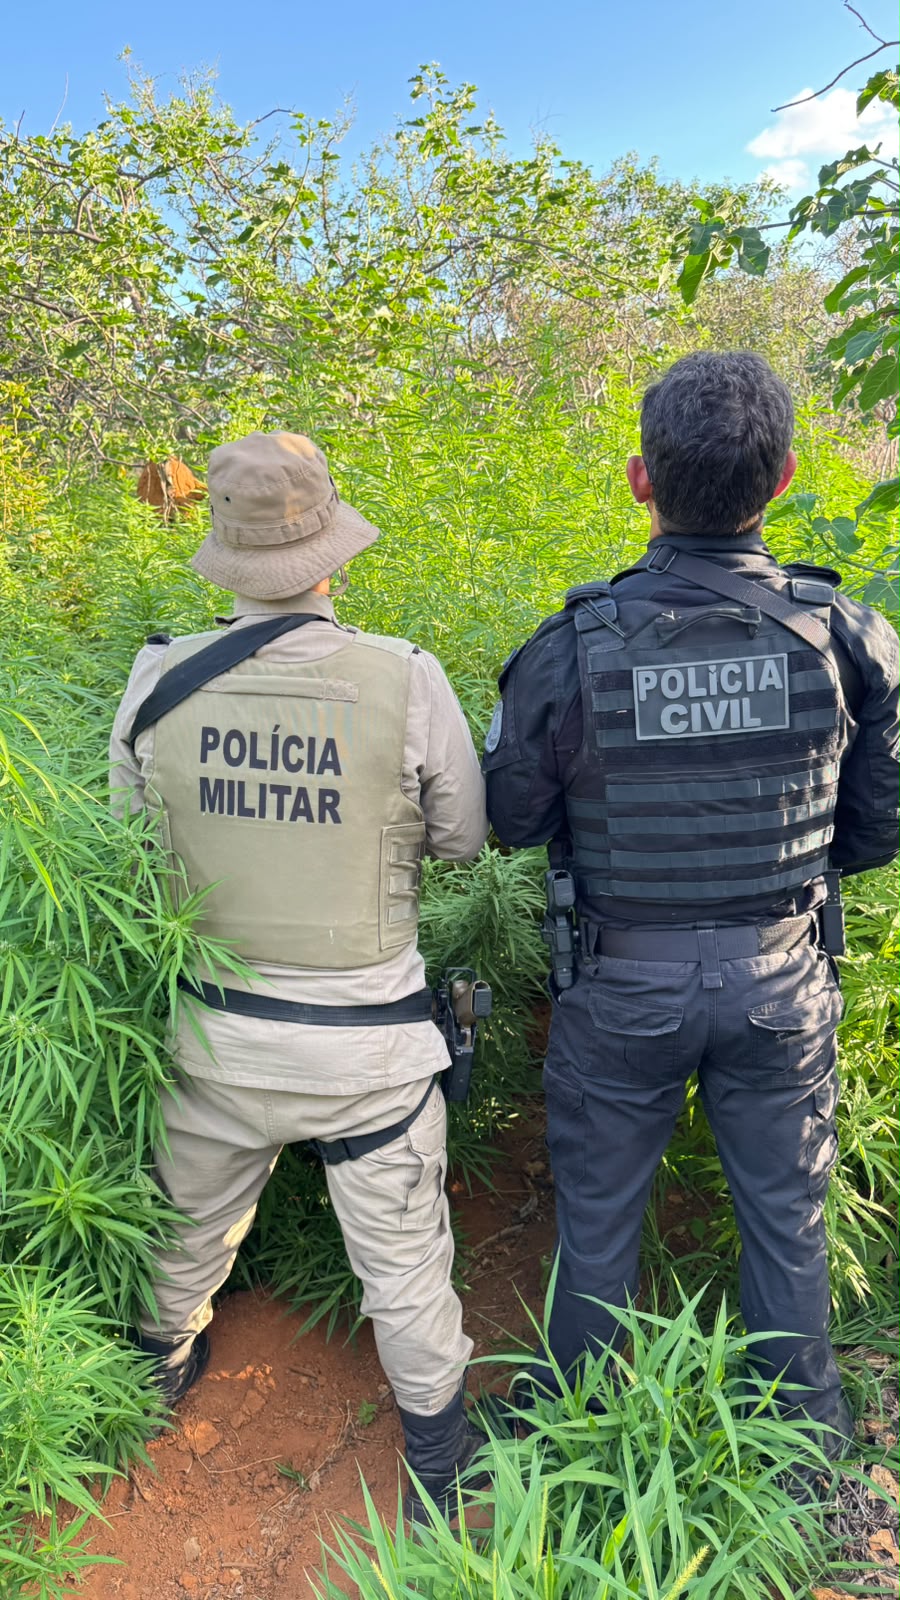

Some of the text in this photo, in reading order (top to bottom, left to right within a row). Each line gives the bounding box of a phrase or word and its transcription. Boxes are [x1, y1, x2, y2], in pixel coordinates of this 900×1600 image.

[660, 697, 762, 734] CIVIL
[200, 724, 342, 776] POLÍCIA
[199, 776, 342, 824] MILITAR
